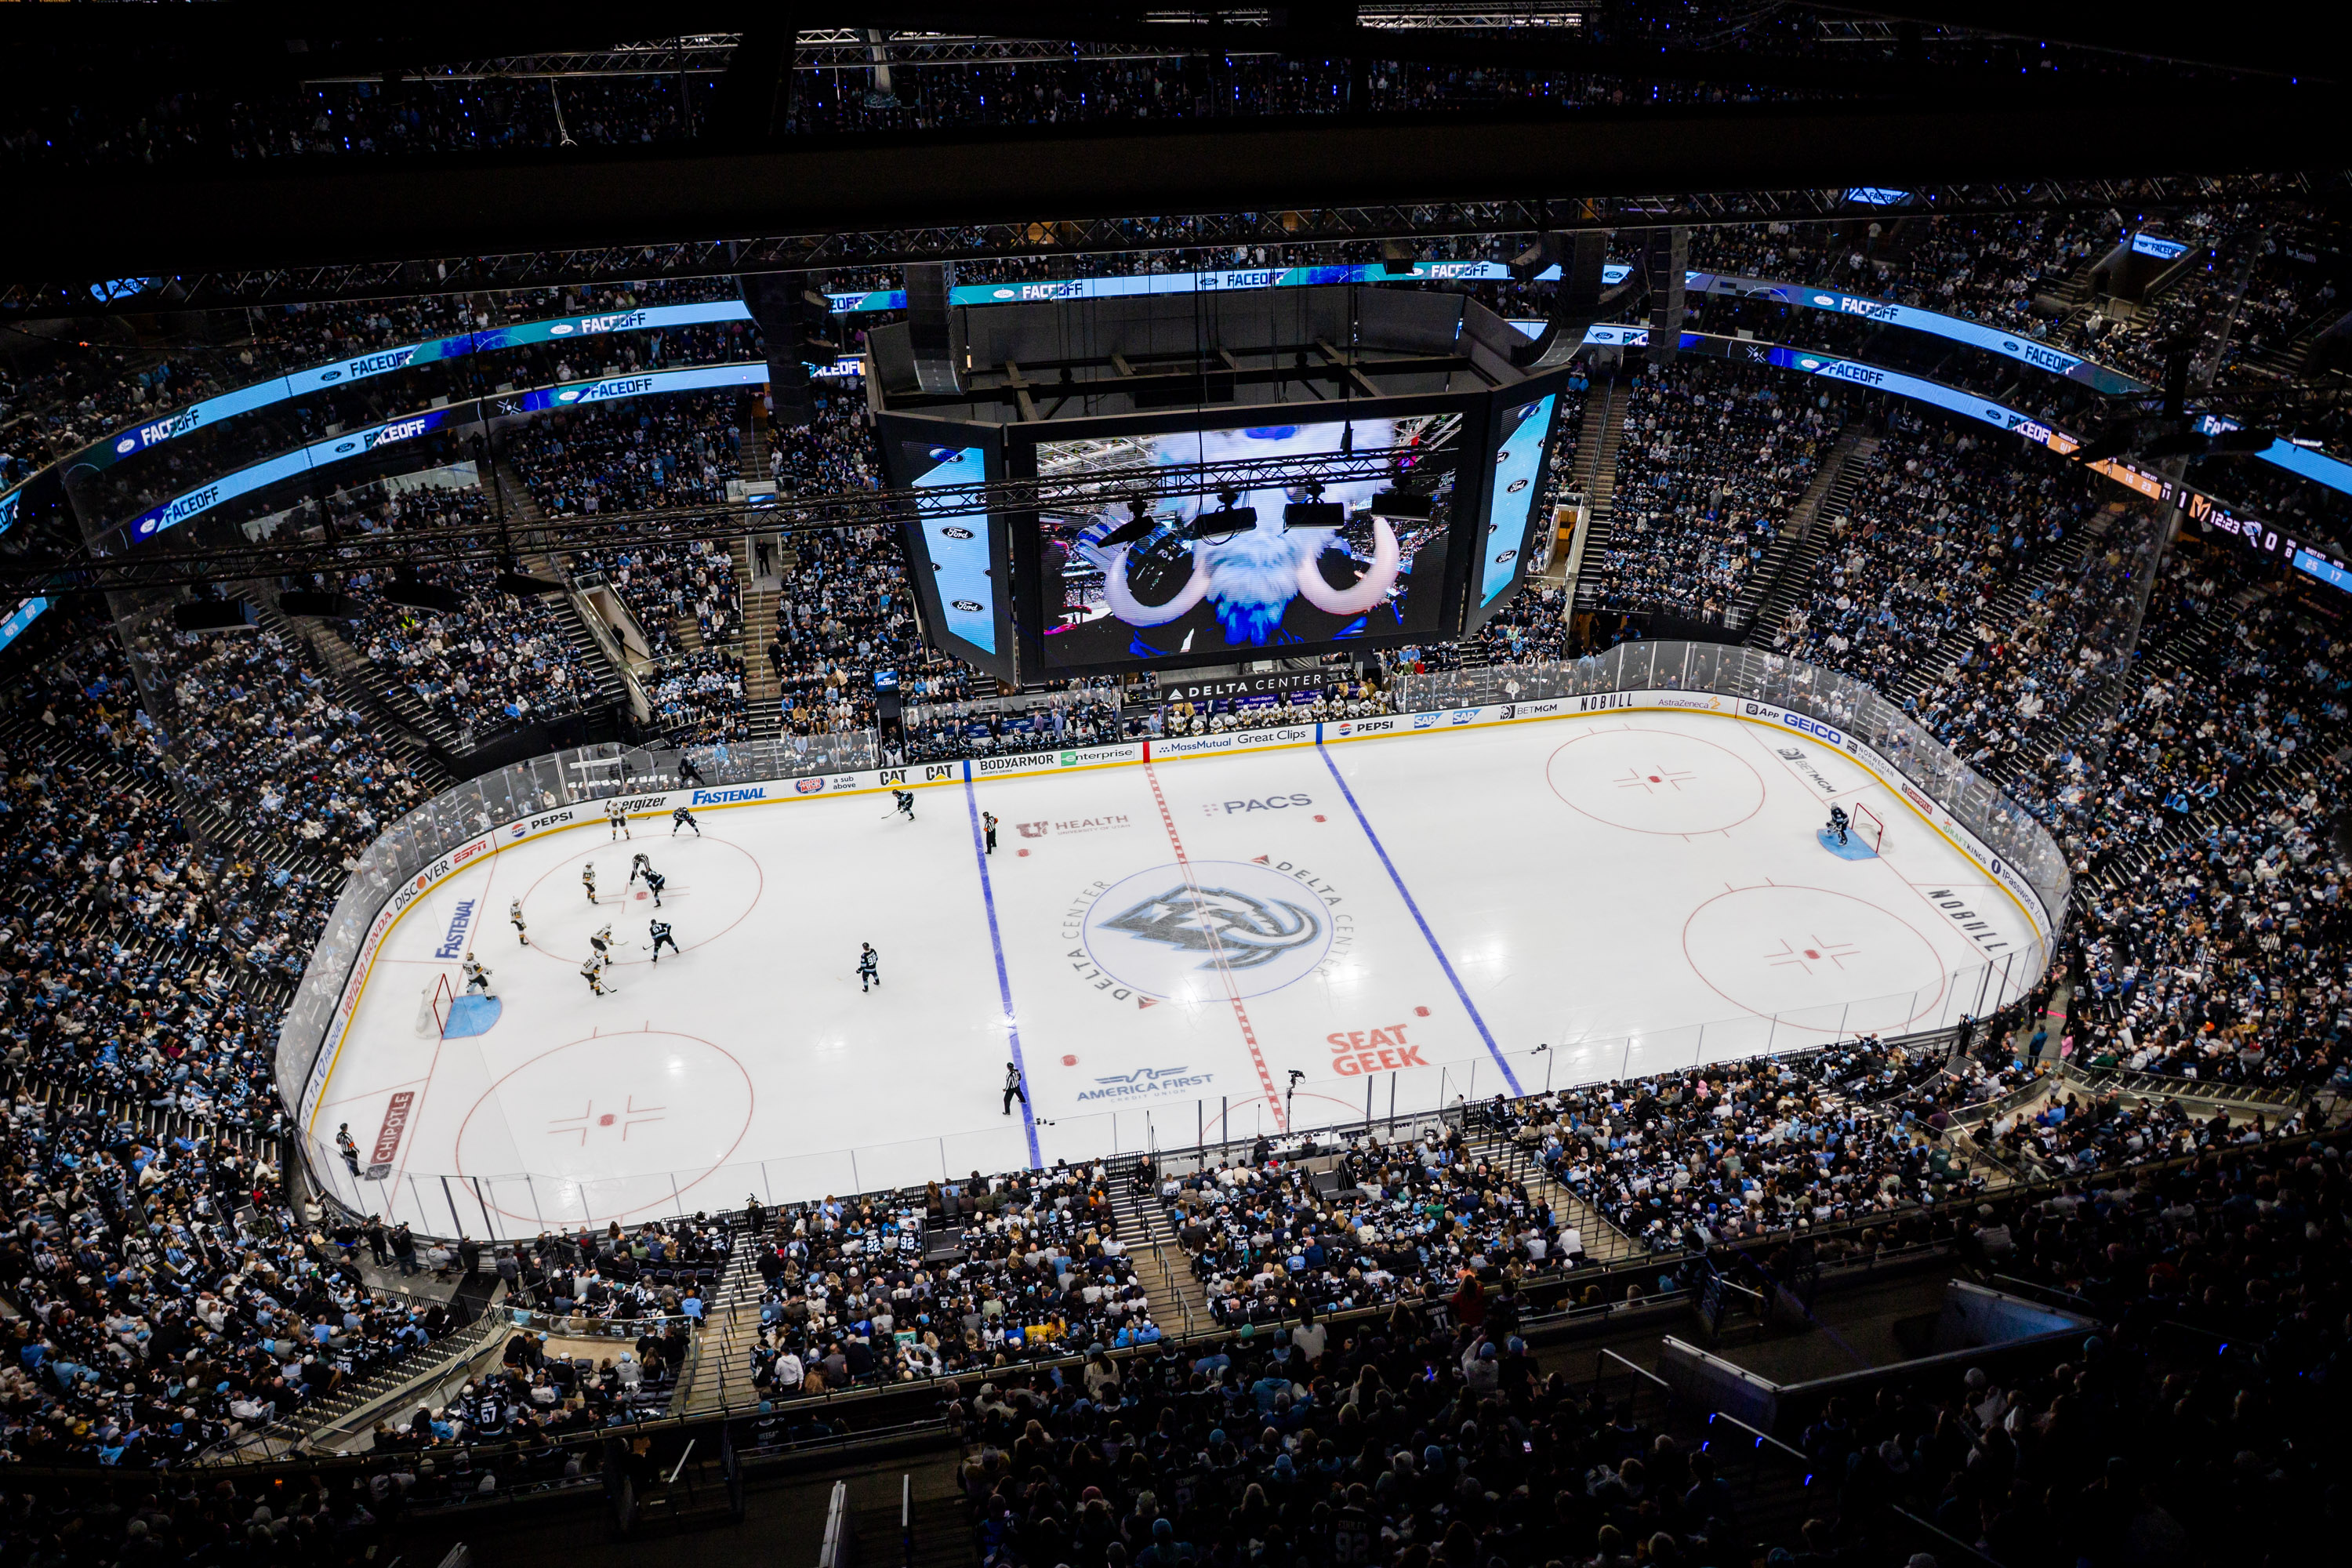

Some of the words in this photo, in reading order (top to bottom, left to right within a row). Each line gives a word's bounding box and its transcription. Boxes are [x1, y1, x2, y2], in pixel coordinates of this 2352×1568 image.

[1227, 271, 1284, 287] FACEOFF
[1431, 263, 1489, 278] FACEOFF
[1022, 282, 1083, 299] FACEOFF
[1841, 297, 1899, 320] FACEOFF
[581, 312, 646, 334] FACEOFF
[350, 350, 414, 377] FACEOFF
[2025, 345, 2076, 376] FACEOFF
[1829, 361, 1884, 386] FACEOFF
[590, 378, 653, 398] FACEOFF
[140, 409, 200, 446] FACEOFF
[363, 419, 426, 448] FACEOFF
[162, 486, 219, 524] FACEOFF
[2179, 491, 2187, 508] 1
[2210, 510, 2241, 535] 12:23
[2264, 532, 2278, 551] 0
[2330, 569, 2342, 582] 17
[1189, 682, 1248, 698] DELTA
[1255, 674, 1322, 691] CENTER
[1517, 704, 1558, 715] BETMGM
[1580, 692, 1633, 711] NOBULL
[1658, 698, 1709, 709] AstraZeneca
[1356, 720, 1393, 732] PEPSI
[1414, 715, 1436, 728] SAP
[1453, 711, 1475, 724] SAP
[1237, 733, 1274, 744] Great
[1276, 730, 1306, 741] Clips
[1784, 713, 1842, 745] GEICO
[1064, 748, 1134, 764] enterprise
[1171, 738, 1231, 752] MassMutual
[979, 754, 1054, 771] BODYARMOR
[1857, 753, 1875, 768] CRUISE
[1859, 746, 1895, 778] NORWEGIAN
[880, 769, 907, 786] CAT
[925, 764, 953, 781] CAT
[1795, 760, 1838, 793] BETMGM
[692, 787, 767, 805] FASTENAL
[1223, 793, 1312, 814] PACS
[1907, 788, 1933, 814] CHIPOTLE
[532, 811, 574, 829] PEPSI
[1054, 815, 1130, 831] HEALTH
[1057, 827, 1099, 836] UNIVERSITY
[453, 840, 487, 864] ESPN
[1942, 823, 1987, 864] DRAFTKINGS
[1275, 861, 1343, 906] DELTA
[2002, 869, 2035, 911] 1Password
[1062, 880, 1112, 939] CENTER
[1928, 888, 2009, 953] NOBULL
[364, 909, 393, 964] HONDA
[434, 898, 476, 960] FASTENAL
[1066, 947, 1133, 1002] DELTA
[342, 963, 366, 1018] verizon
[323, 1018, 343, 1065] FANDUEL
[1326, 1023, 1408, 1054] SEAT
[1332, 1044, 1431, 1077] GEEK
[1076, 1080, 1158, 1102] AMERICA
[1162, 1073, 1215, 1088] FIRST
[1109, 1094, 1148, 1104] CREDIT
[1153, 1088, 1187, 1098] UNION
[301, 1078, 320, 1127] DELTA
[376, 1094, 410, 1161] CHIPOTLE
[866, 1240, 880, 1252] 22
[900, 1236, 915, 1250] 92
[481, 1406, 497, 1424] 67
